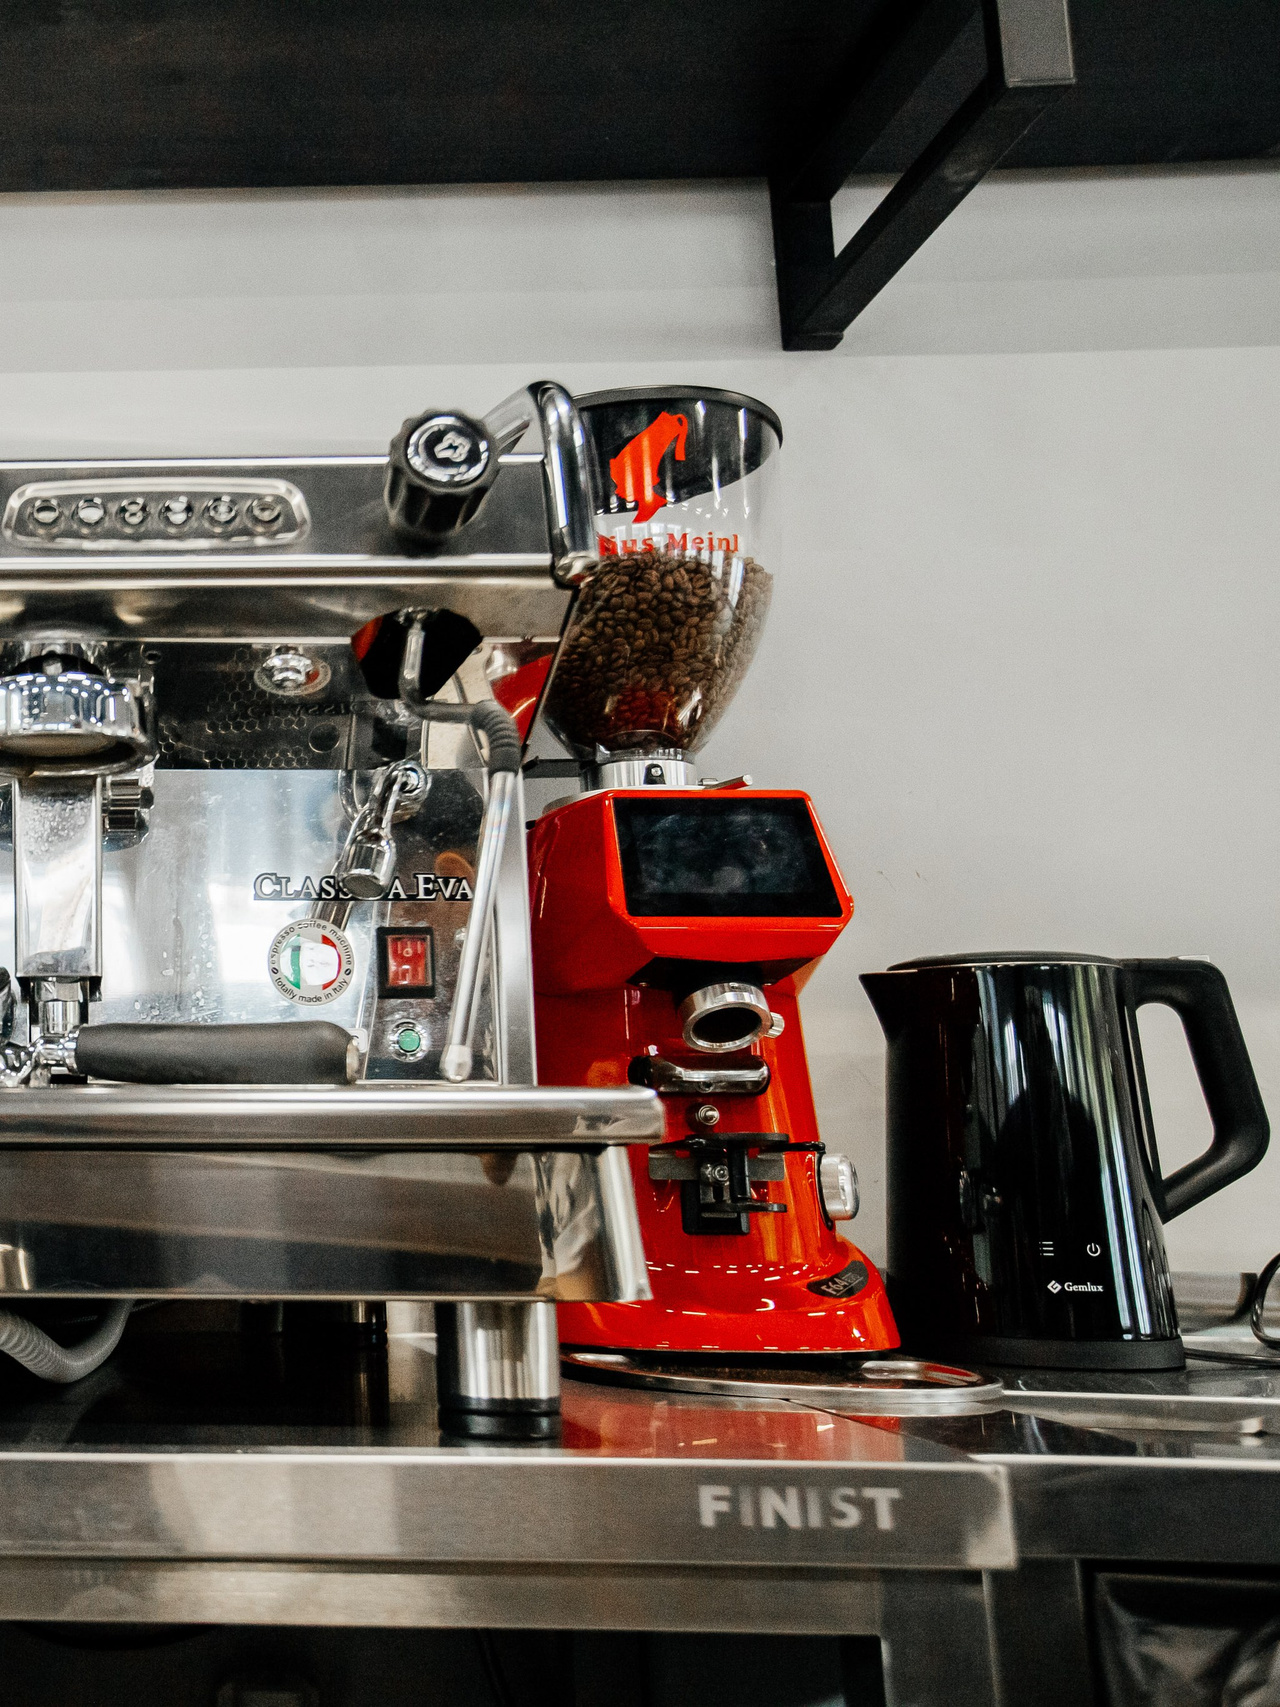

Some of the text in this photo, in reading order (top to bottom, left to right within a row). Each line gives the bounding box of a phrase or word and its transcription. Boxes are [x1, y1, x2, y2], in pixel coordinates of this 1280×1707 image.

[667, 531, 739, 553] Meinl
[270, 920, 352, 966] espresso coffee machine
[275, 977, 349, 1003] totally made in Italy
[1064, 1282, 1104, 1292] Gemlux
[698, 1484, 903, 1531] FINIST
